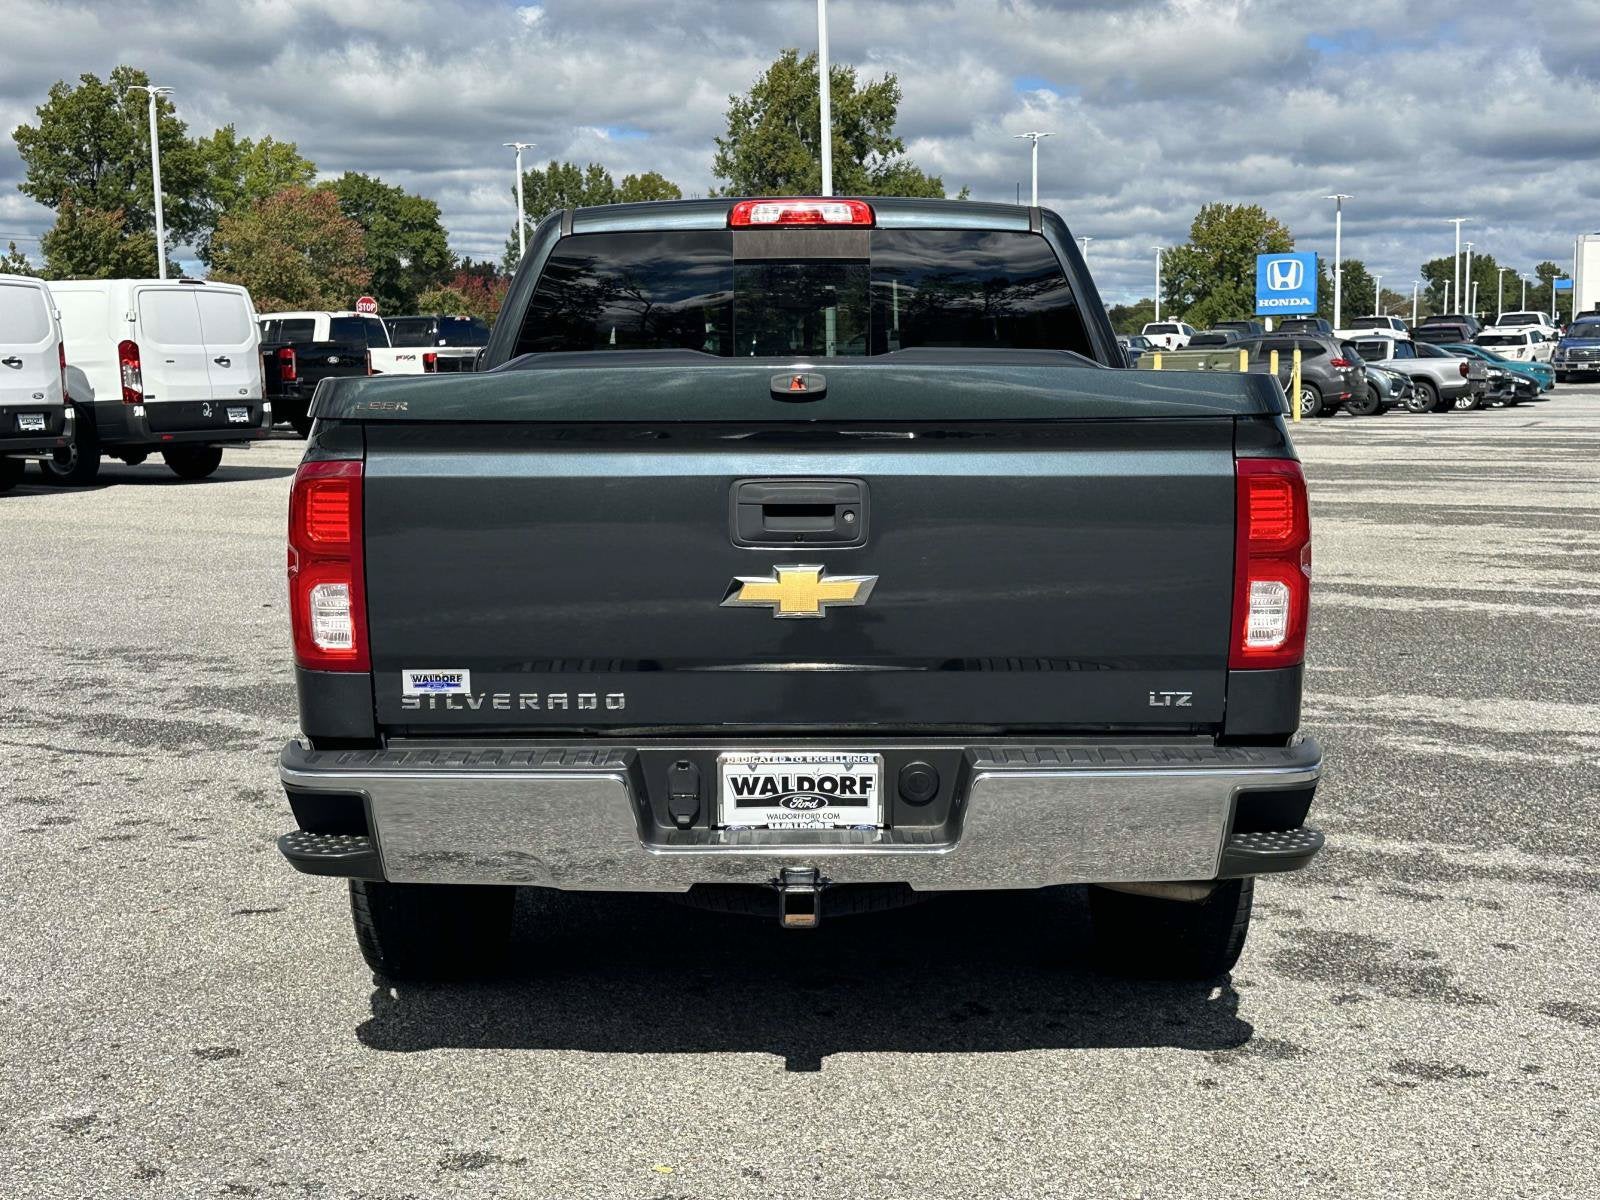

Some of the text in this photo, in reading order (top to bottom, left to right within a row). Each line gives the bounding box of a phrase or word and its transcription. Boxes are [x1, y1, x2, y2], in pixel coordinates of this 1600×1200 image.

[358, 303, 375, 311] STOP
[1258, 297, 1311, 306] HONDA
[412, 673, 463, 683] WALDORF
[401, 692, 627, 710] SILVERADO
[1149, 691, 1193, 707] LTZ
[725, 755, 874, 764] DEDICATED TO EXCELLENCE
[730, 775, 874, 796] WALDORF
[788, 796, 819, 809] Ford
